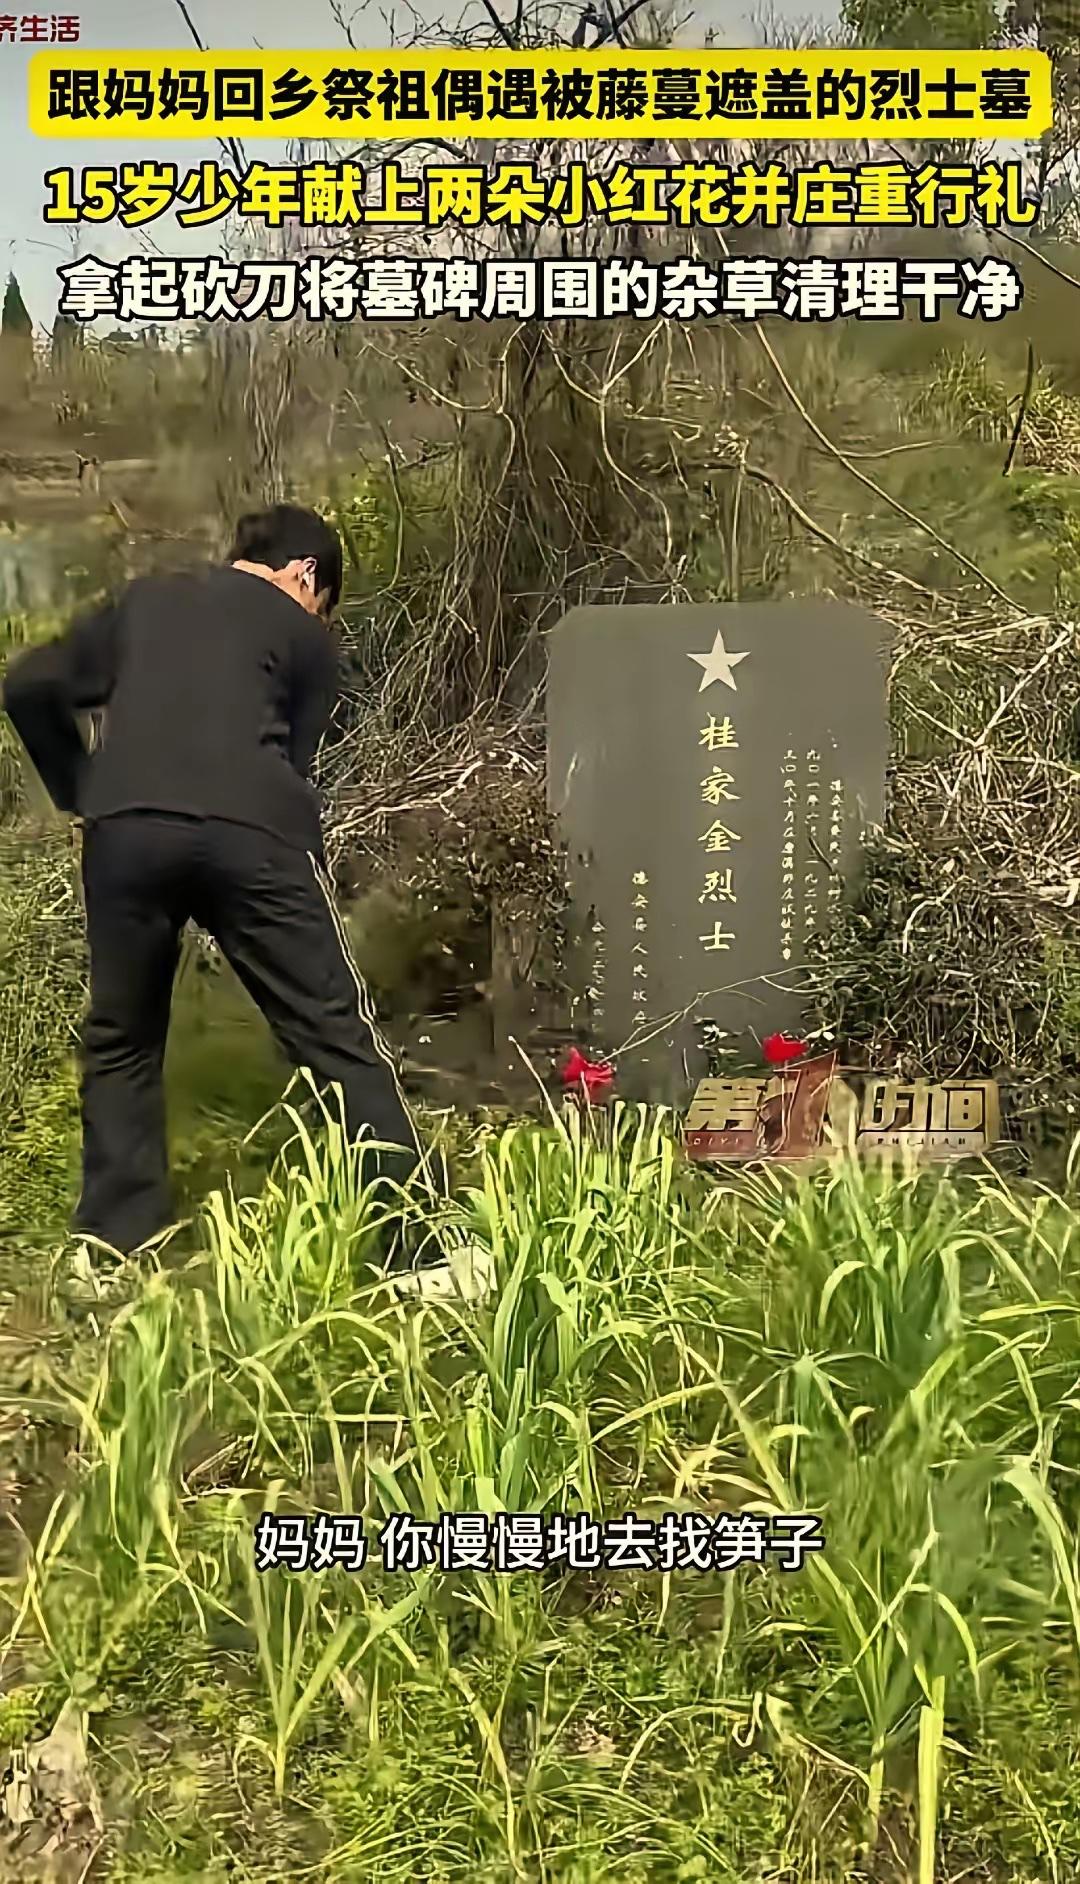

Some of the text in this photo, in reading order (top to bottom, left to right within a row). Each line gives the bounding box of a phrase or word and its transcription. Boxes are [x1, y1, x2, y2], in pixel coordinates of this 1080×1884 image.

[697, 712, 742, 952] 桂家金烈士
